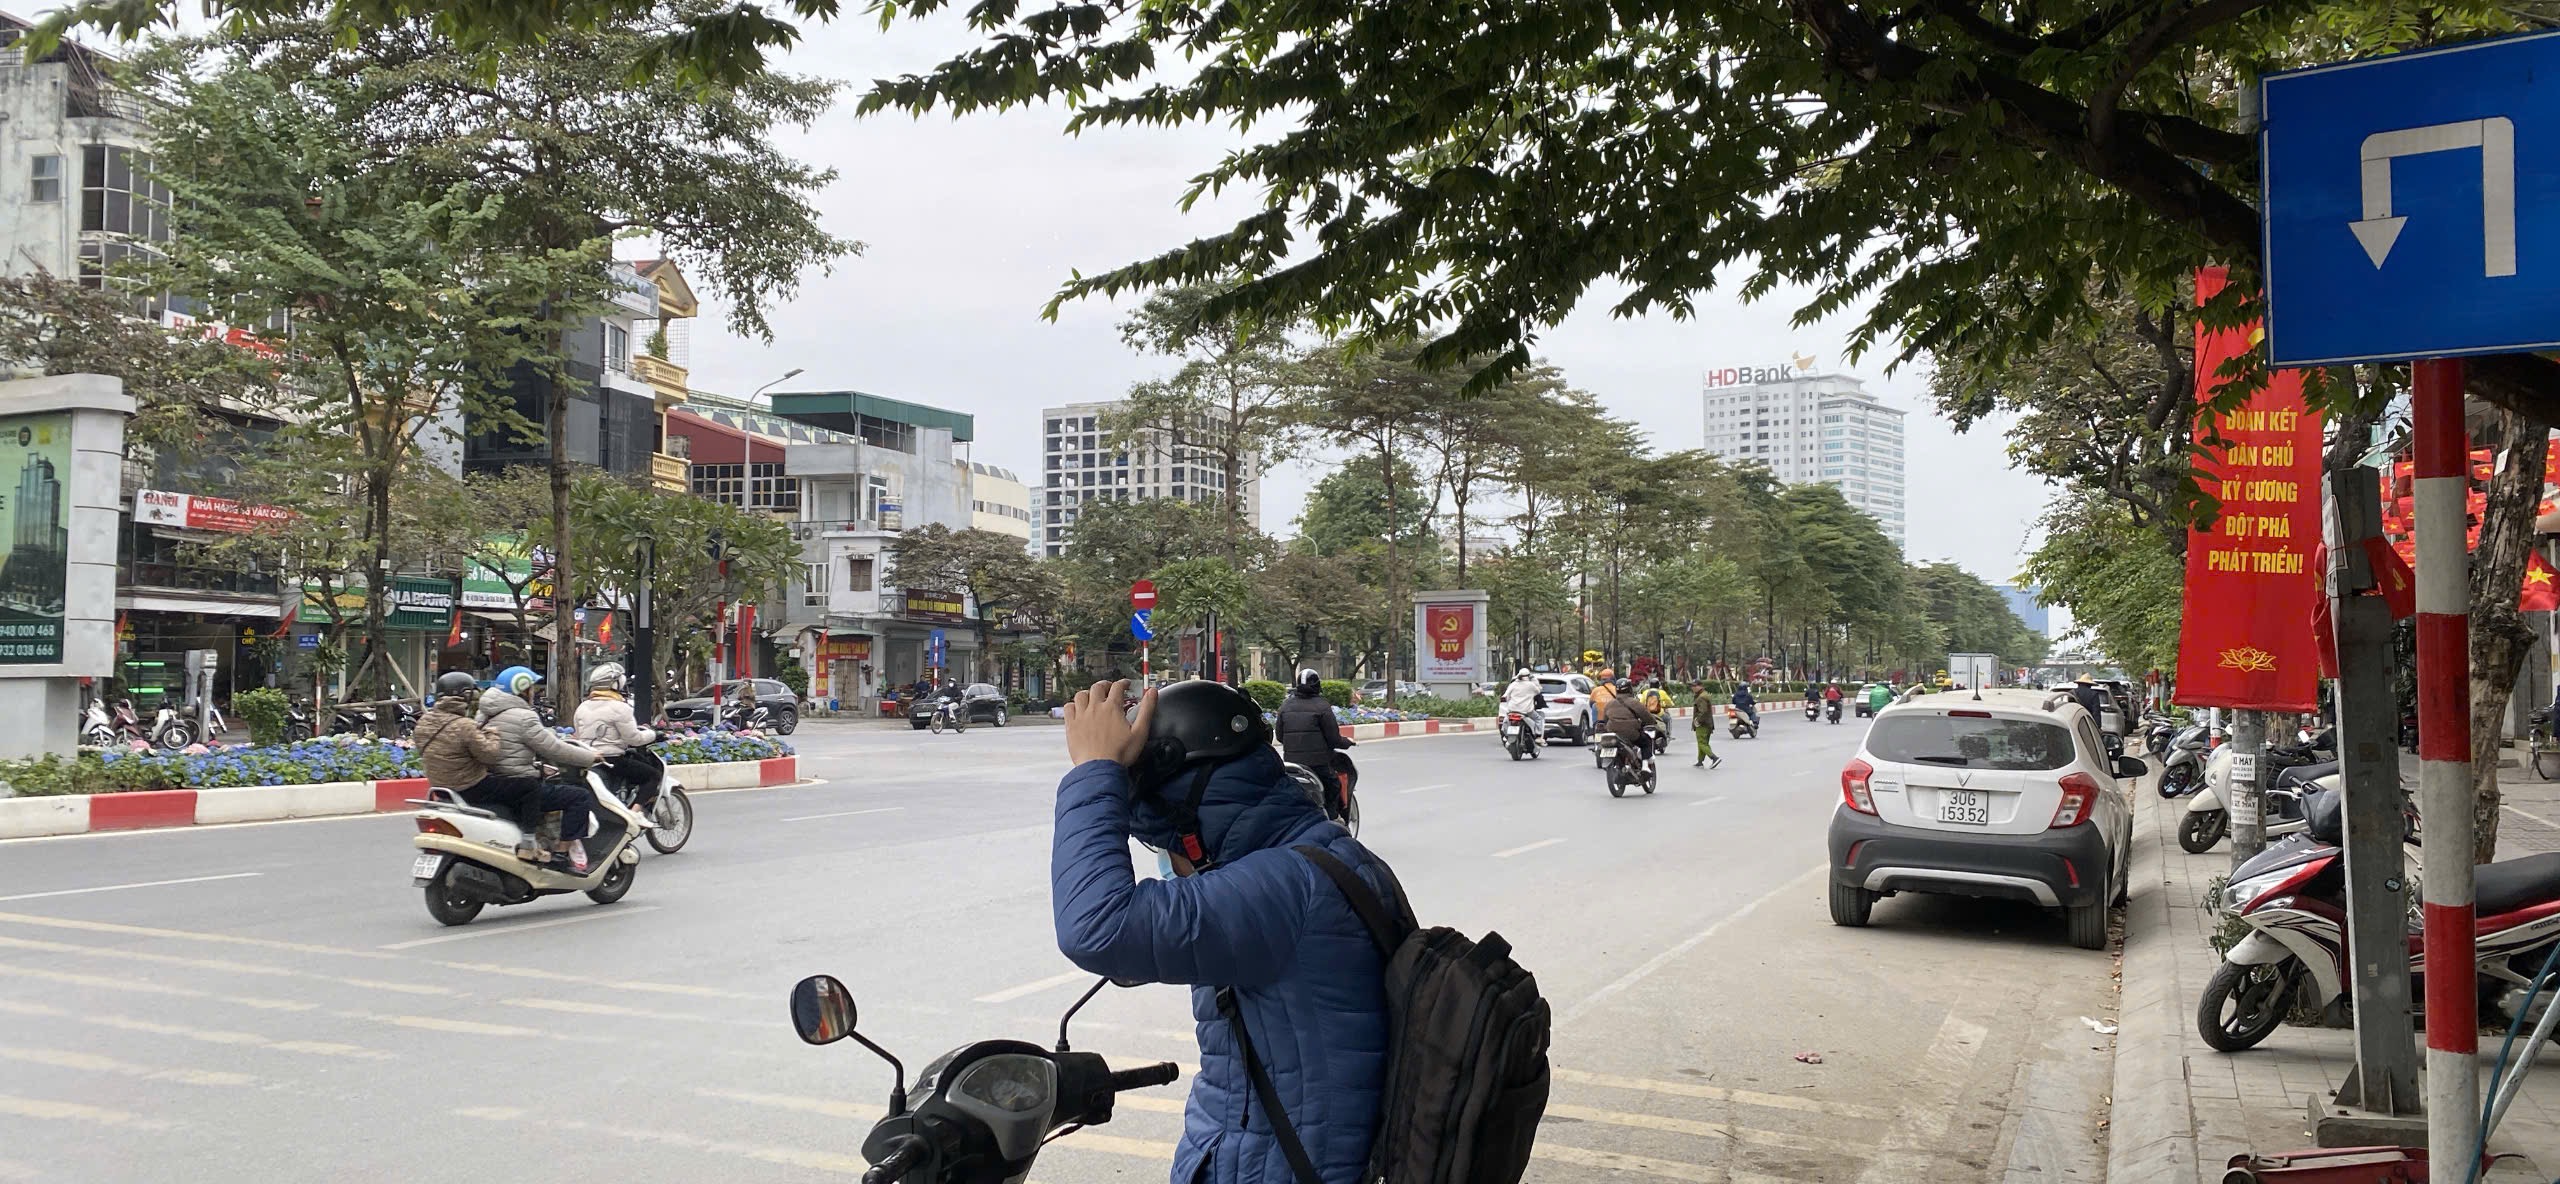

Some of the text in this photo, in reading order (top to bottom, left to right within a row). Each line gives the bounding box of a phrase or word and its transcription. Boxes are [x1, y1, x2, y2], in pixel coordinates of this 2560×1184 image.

[1708, 364, 1793, 387] HDBank
[2269, 406, 2298, 431] KẾT
[2228, 440, 2294, 467] DÂN CHỦ
[2222, 474, 2298, 503] KỶ CƯƠNG
[2226, 512, 2290, 541] ĐỘT PHÁ
[2208, 545, 2304, 574] PHÁT TRIỂN!
[17, 625, 35, 637] 000
[1440, 643, 1460, 652] XIV
[1950, 791, 1976, 806] 30G
[1941, 806, 1986, 823] 153.52
